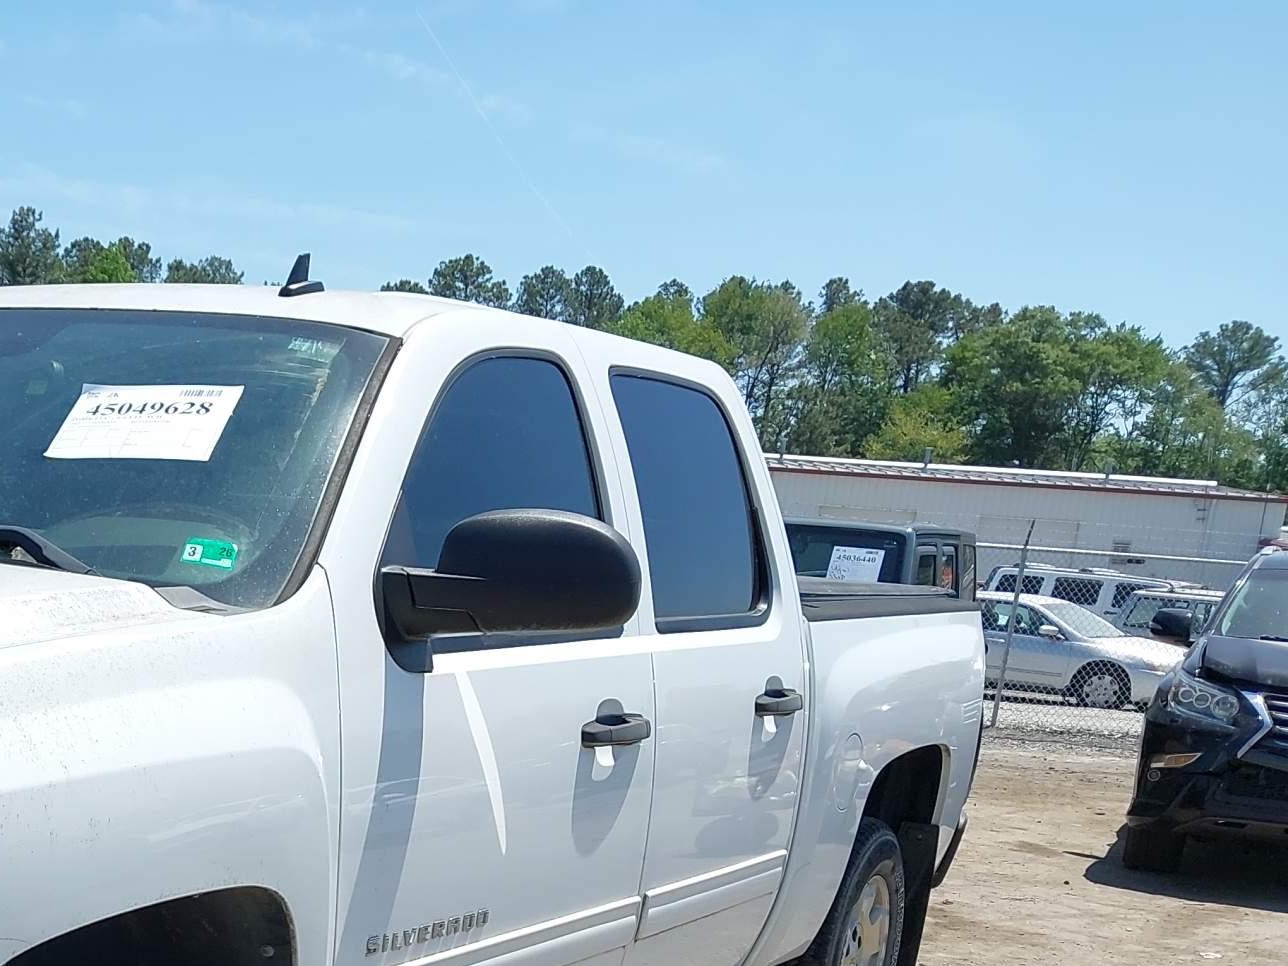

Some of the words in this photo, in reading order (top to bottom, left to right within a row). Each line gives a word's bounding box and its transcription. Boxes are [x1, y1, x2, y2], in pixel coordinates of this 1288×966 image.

[86, 401, 214, 416] 45049628
[188, 546, 197, 557] 3
[218, 547, 232, 557] 26
[365, 908, 490, 957] SILVERADO
